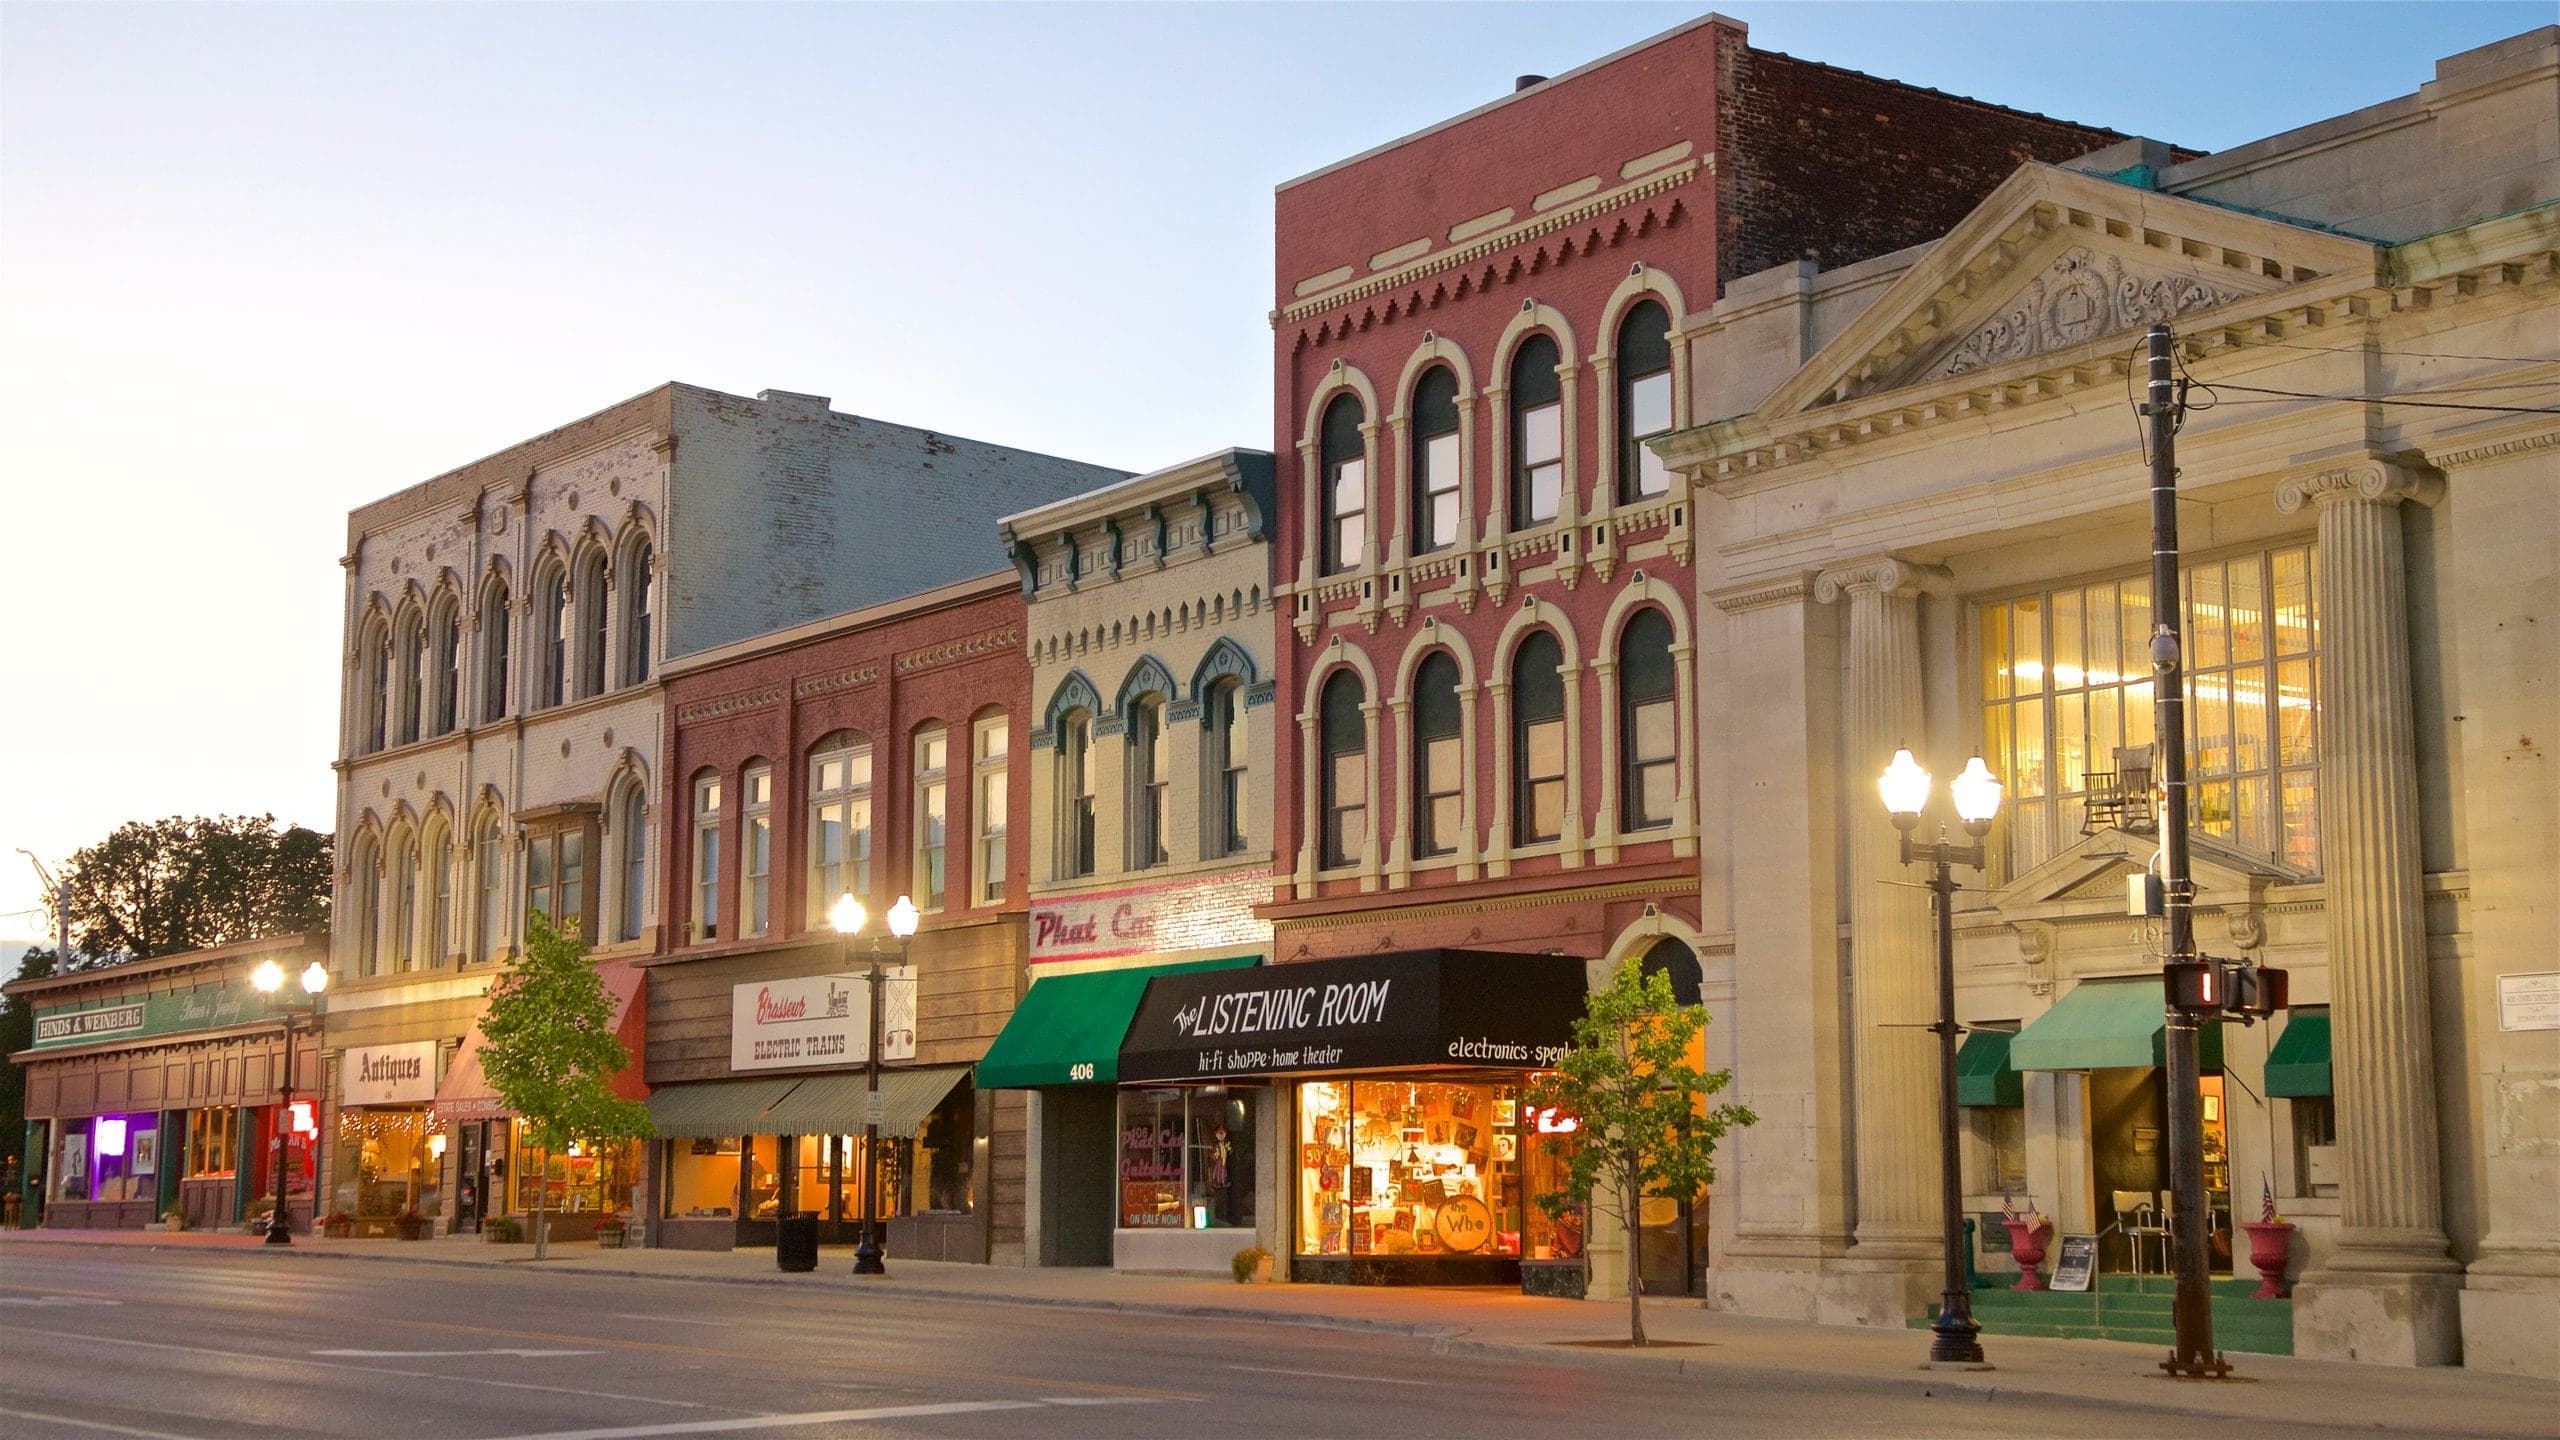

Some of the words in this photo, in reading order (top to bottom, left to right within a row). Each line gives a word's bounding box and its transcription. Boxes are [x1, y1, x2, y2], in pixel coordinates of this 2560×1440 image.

[1035, 911, 1097, 947] Phat
[2128, 926, 2164, 944] 40
[756, 985, 807, 1025] Brasseur
[1173, 1004, 1198, 1037] The
[1192, 987, 1316, 1037] LISTENING
[1317, 979, 1391, 1027] ROOM
[40, 1020, 72, 1038] HINDS
[73, 1017, 82, 1033] &
[84, 1008, 140, 1032] WEINBERG
[754, 1038, 801, 1060] ELECTRIC
[806, 1034, 846, 1056] TRAINS
[1198, 1050, 1223, 1071] hi-fi
[1272, 1048, 1299, 1066] home
[1303, 1044, 1343, 1064] theater
[1448, 1036, 1528, 1060] electronics
[1535, 1041, 1577, 1067] speak
[359, 1052, 422, 1087] Antiques
[1070, 1063, 1094, 1080] 406
[1130, 1214, 1140, 1225] ON
[1142, 1213, 1159, 1225] SALE
[1446, 1214, 1484, 1232] Who
